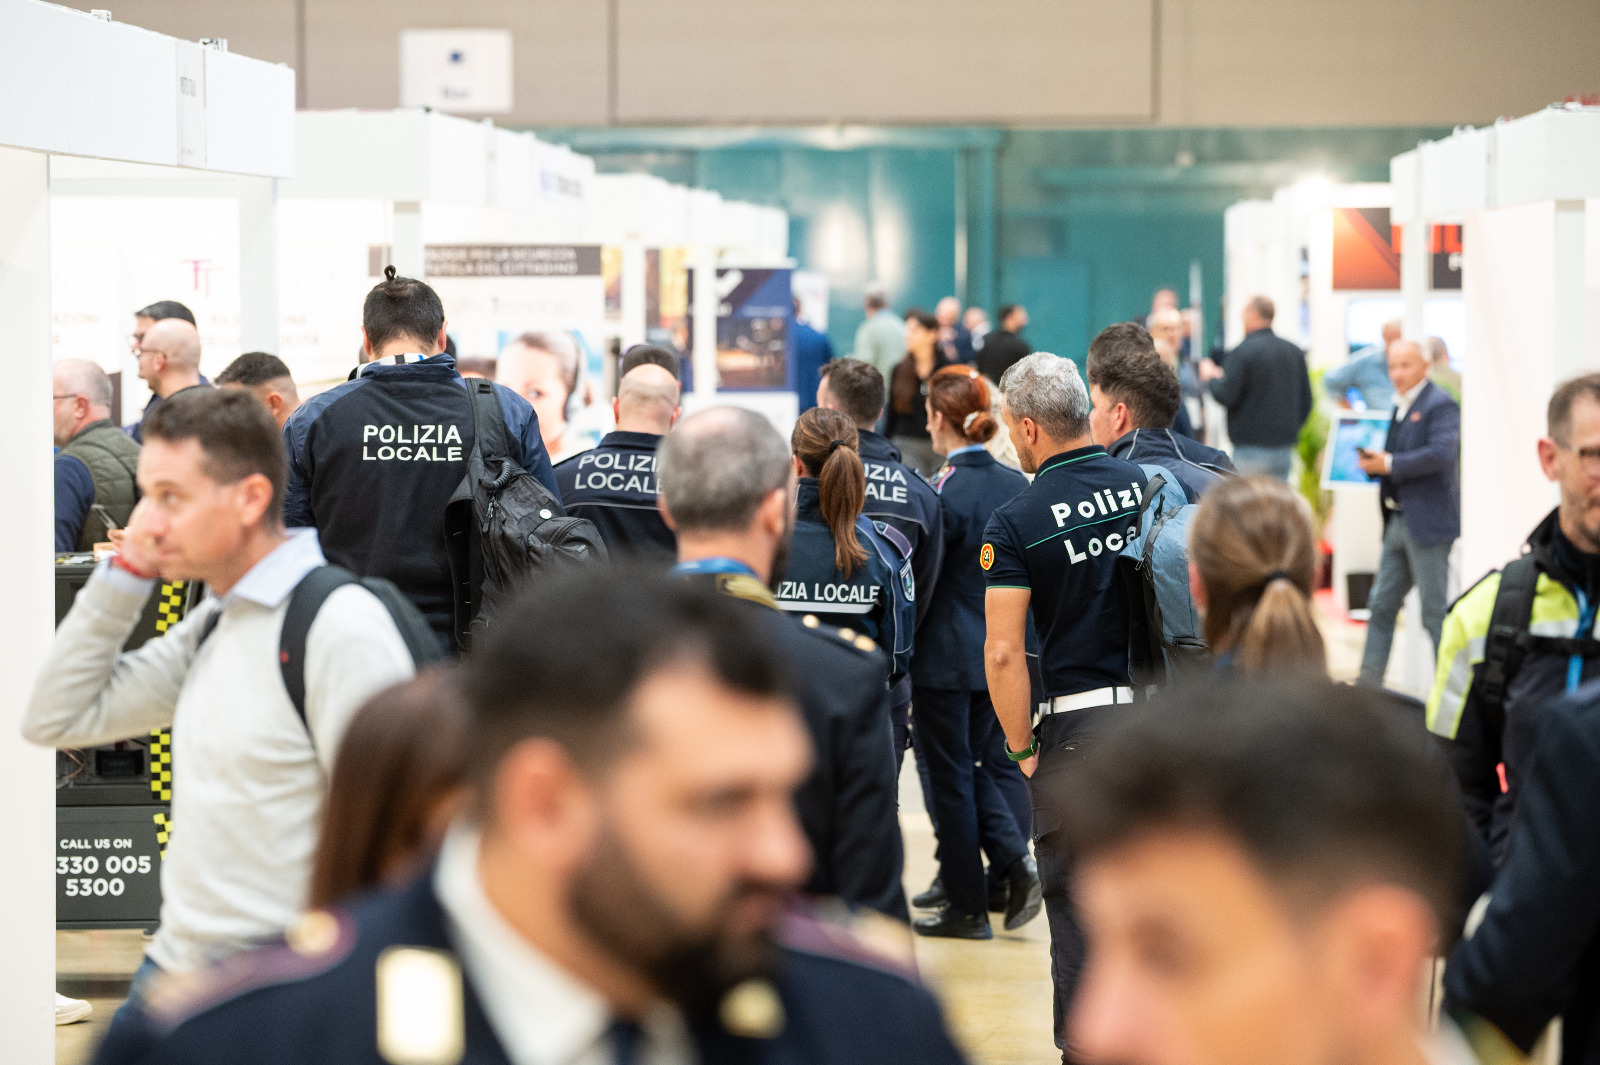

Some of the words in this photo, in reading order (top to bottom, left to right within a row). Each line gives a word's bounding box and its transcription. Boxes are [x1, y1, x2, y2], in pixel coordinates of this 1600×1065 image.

[363, 424, 463, 444] POLIZIA
[362, 446, 463, 461] LOCALE
[578, 453, 660, 473] POLIZI
[864, 463, 908, 485] IZIA
[865, 483, 908, 503] ALE
[1050, 481, 1142, 527] Polizi
[1064, 526, 1136, 565] Loca
[814, 583, 881, 603] LOCALE
[60, 839, 92, 849] CALL
[94, 839, 111, 849] US
[113, 838, 132, 849] ON
[105, 855, 152, 874] 005
[65, 877, 125, 896] 5300
